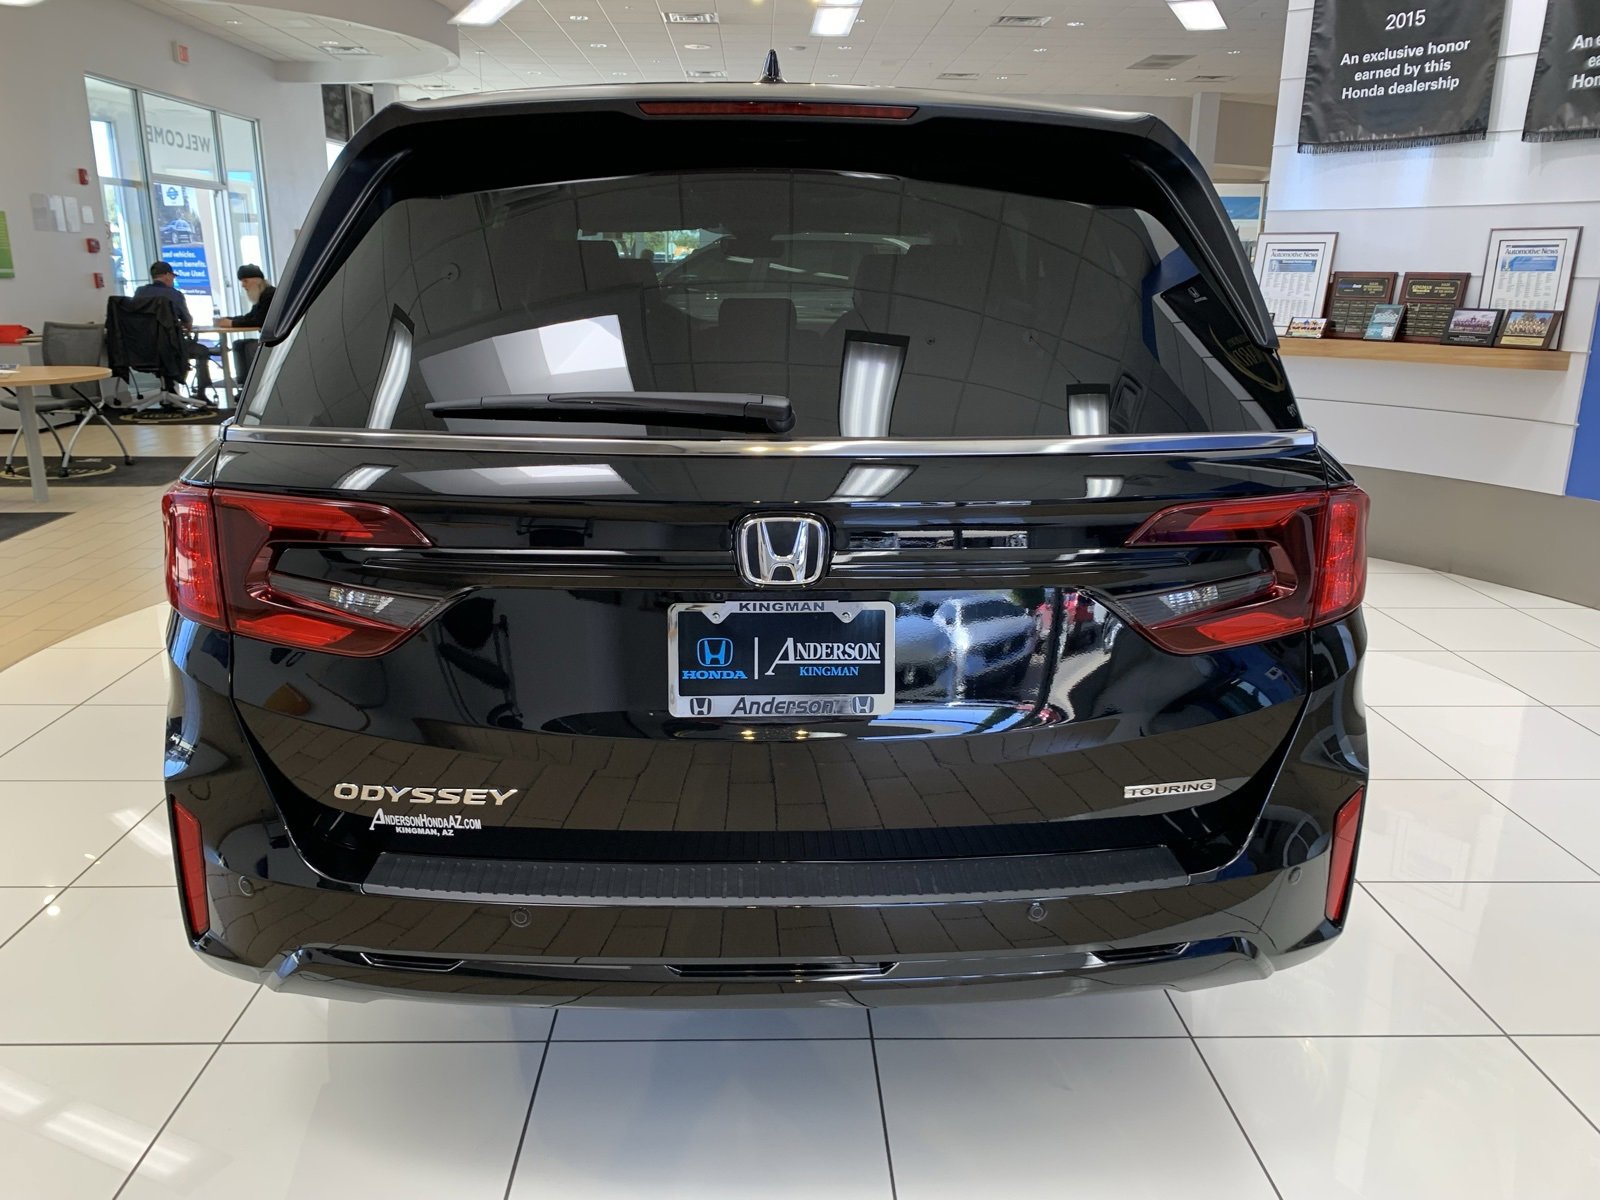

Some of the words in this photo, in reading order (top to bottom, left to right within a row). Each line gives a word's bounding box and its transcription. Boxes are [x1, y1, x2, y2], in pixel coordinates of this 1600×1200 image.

[1385, 9, 1426, 30] 2015
[1572, 34, 1593, 50] An
[1340, 53, 1359, 66] An
[1362, 45, 1424, 63] exclusive
[1427, 39, 1471, 55] honor
[1354, 64, 1401, 81] earned
[1404, 62, 1422, 78] by
[1424, 58, 1451, 73] this
[1341, 84, 1385, 100] Honda
[1388, 76, 1460, 95] dealership
[1571, 73, 1600, 89] Hon
[738, 601, 825, 612] KINGMAN
[764, 637, 881, 676] ANDERSON
[681, 669, 748, 680] HONDA
[799, 666, 859, 677] KINGMAN
[730, 696, 834, 716] Anderson
[333, 782, 519, 806] ODYSSEY
[1129, 781, 1213, 797] TOURING
[395, 826, 441, 837] KINGMAN,
